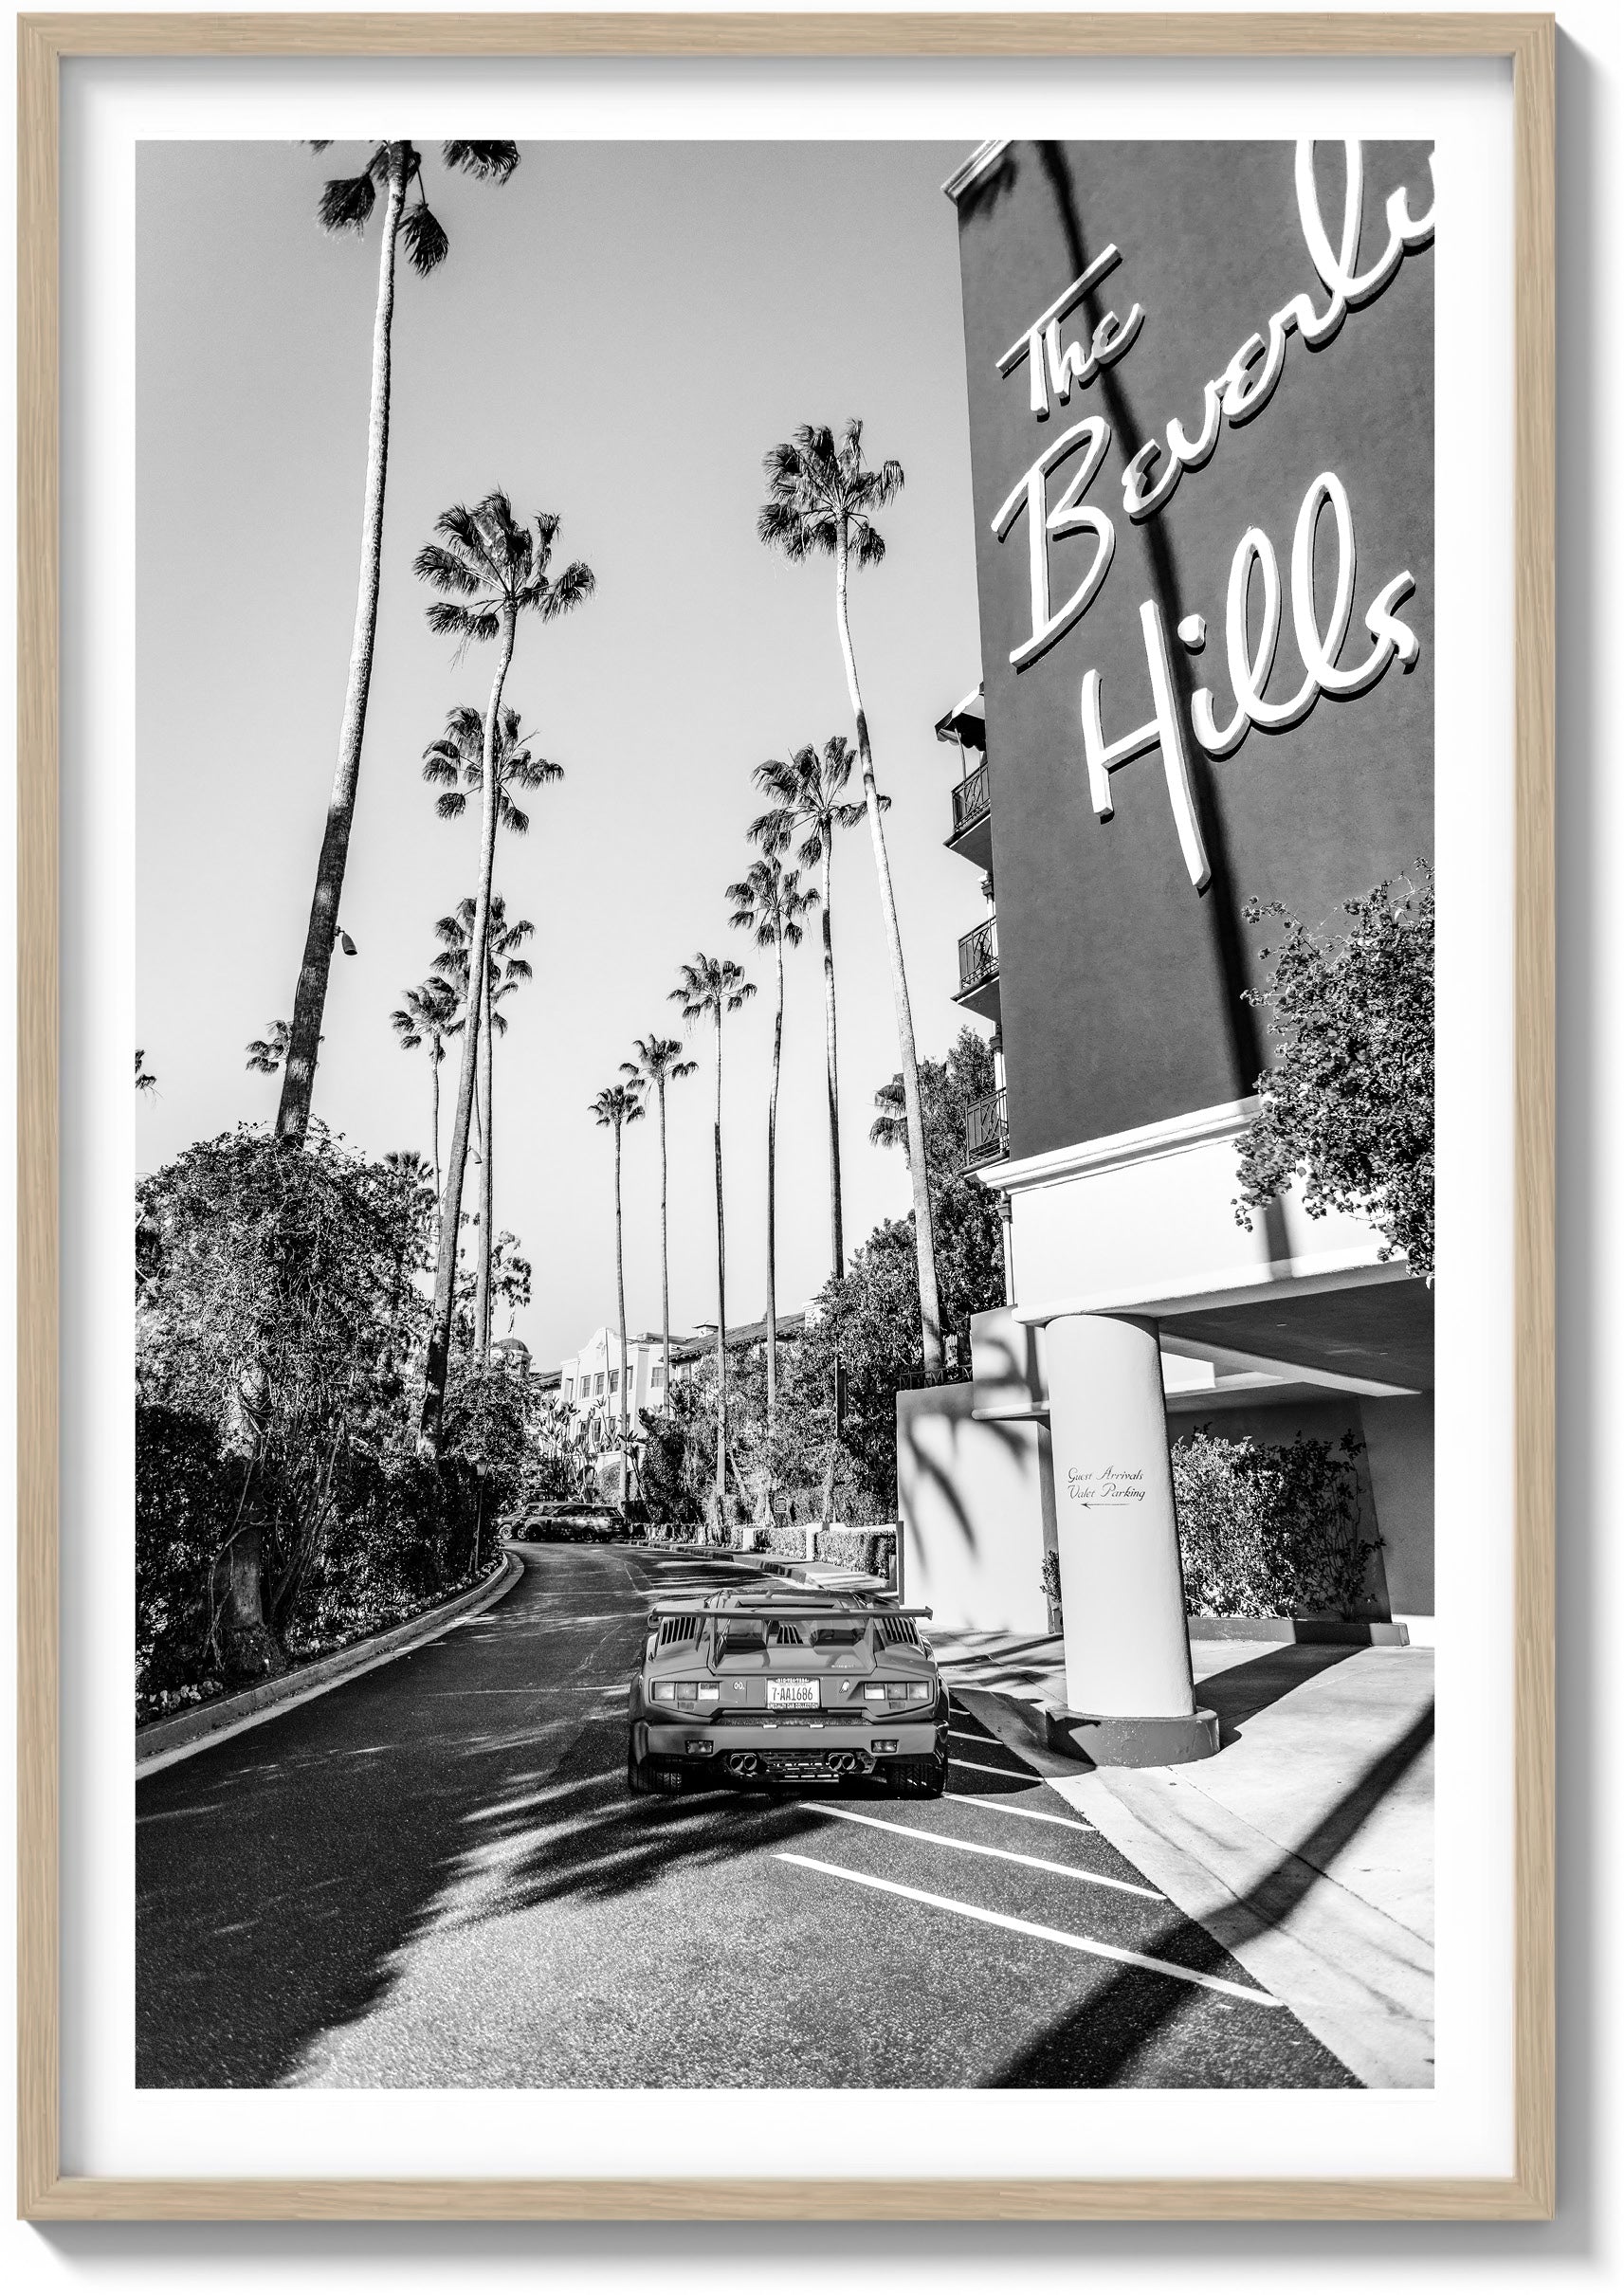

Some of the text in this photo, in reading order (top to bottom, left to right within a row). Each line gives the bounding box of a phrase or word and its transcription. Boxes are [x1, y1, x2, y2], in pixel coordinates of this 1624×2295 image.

[996, 244, 1144, 416] The
[1081, 471, 1418, 889] Hills
[1067, 1465, 1144, 1484] Guest Arrivals
[1067, 1482, 1146, 1502] Valet Parking
[772, 1686, 813, 1701] 7-AA1686
